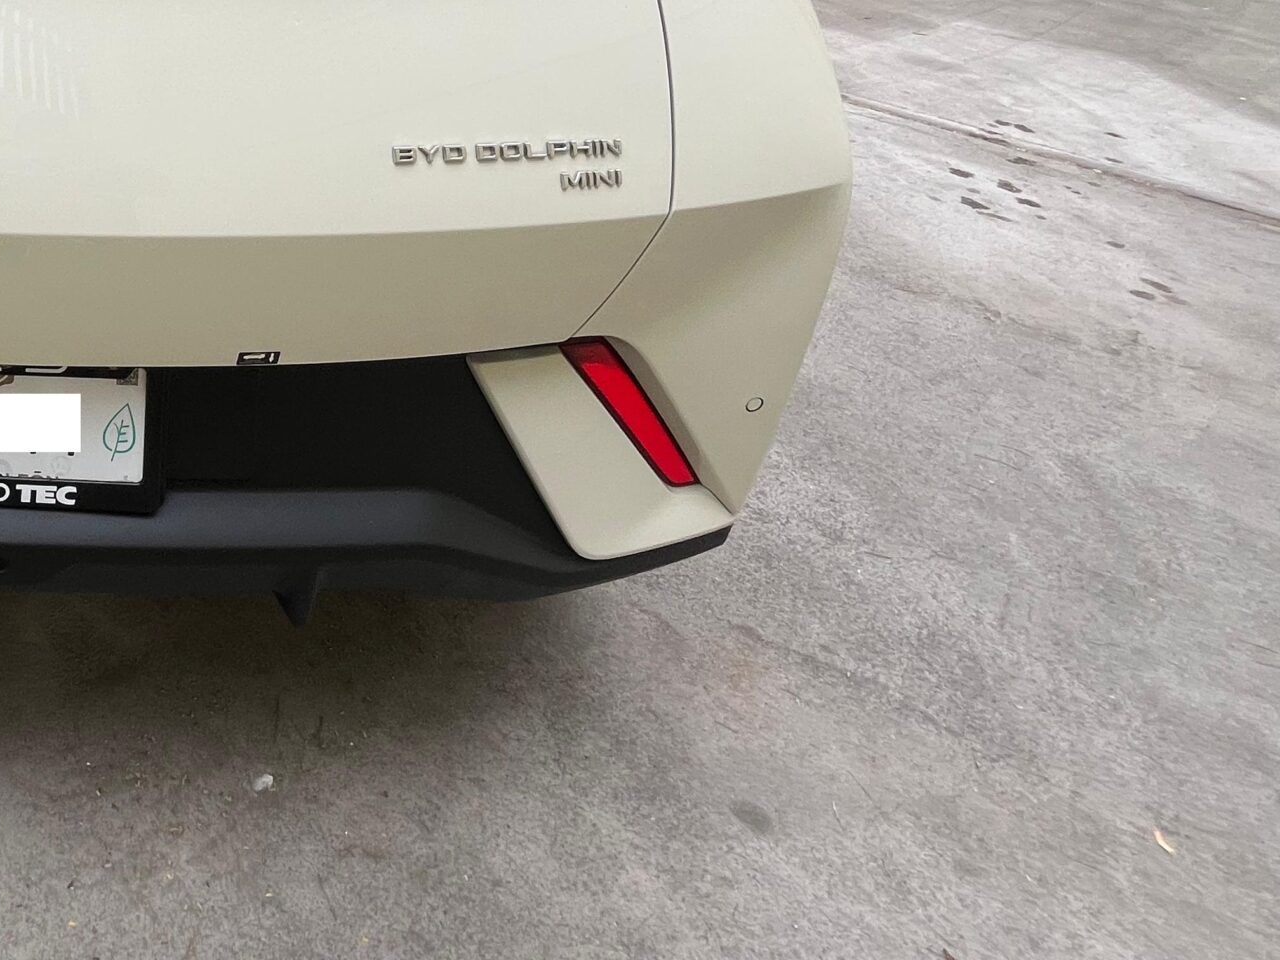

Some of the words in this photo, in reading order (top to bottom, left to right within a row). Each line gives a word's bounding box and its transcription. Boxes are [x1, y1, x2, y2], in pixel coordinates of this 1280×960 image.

[391, 143, 468, 166] BYD
[474, 138, 623, 163] DOLPHIN
[559, 168, 623, 192] MINI
[15, 483, 78, 506] TEC
